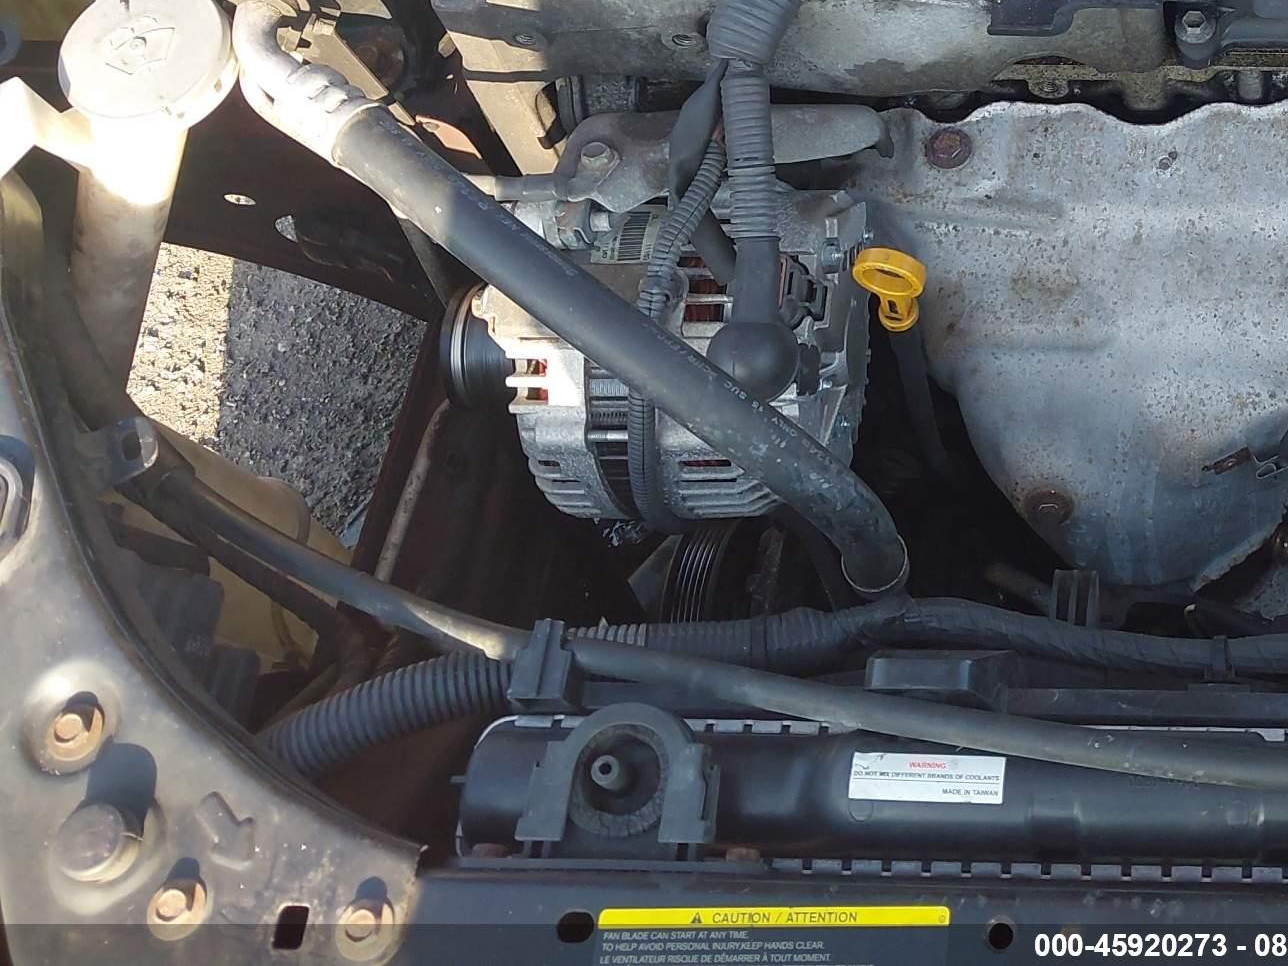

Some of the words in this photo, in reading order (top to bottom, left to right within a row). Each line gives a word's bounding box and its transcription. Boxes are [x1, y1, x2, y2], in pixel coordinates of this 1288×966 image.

[908, 762, 946, 770] WARNING
[712, 912, 770, 923] CAUTION
[786, 912, 858, 923] ATTENTION
[603, 931, 619, 939] FAN
[621, 931, 648, 939] BLADE
[650, 931, 668, 939] CAN
[671, 930, 696, 939] START
[697, 930, 707, 938] AT
[709, 930, 727, 938] ANY
[602, 942, 613, 951] TO
[615, 942, 637, 951] HELP
[638, 942, 664, 951] AVOID
[665, 942, 710, 950] PERSONAL
[764, 941, 793, 950] HANDS
[795, 941, 824, 949] CLEAR.
[600, 955, 609, 963] LE
[611, 954, 665, 963] VENTILATEUR
[667, 954, 698, 963] RISQUE
[700, 954, 711, 962] DE
[714, 952, 760, 962] DÉMARRER
[770, 953, 791, 961] TOUT
[793, 953, 831, 961] MOMENT.
